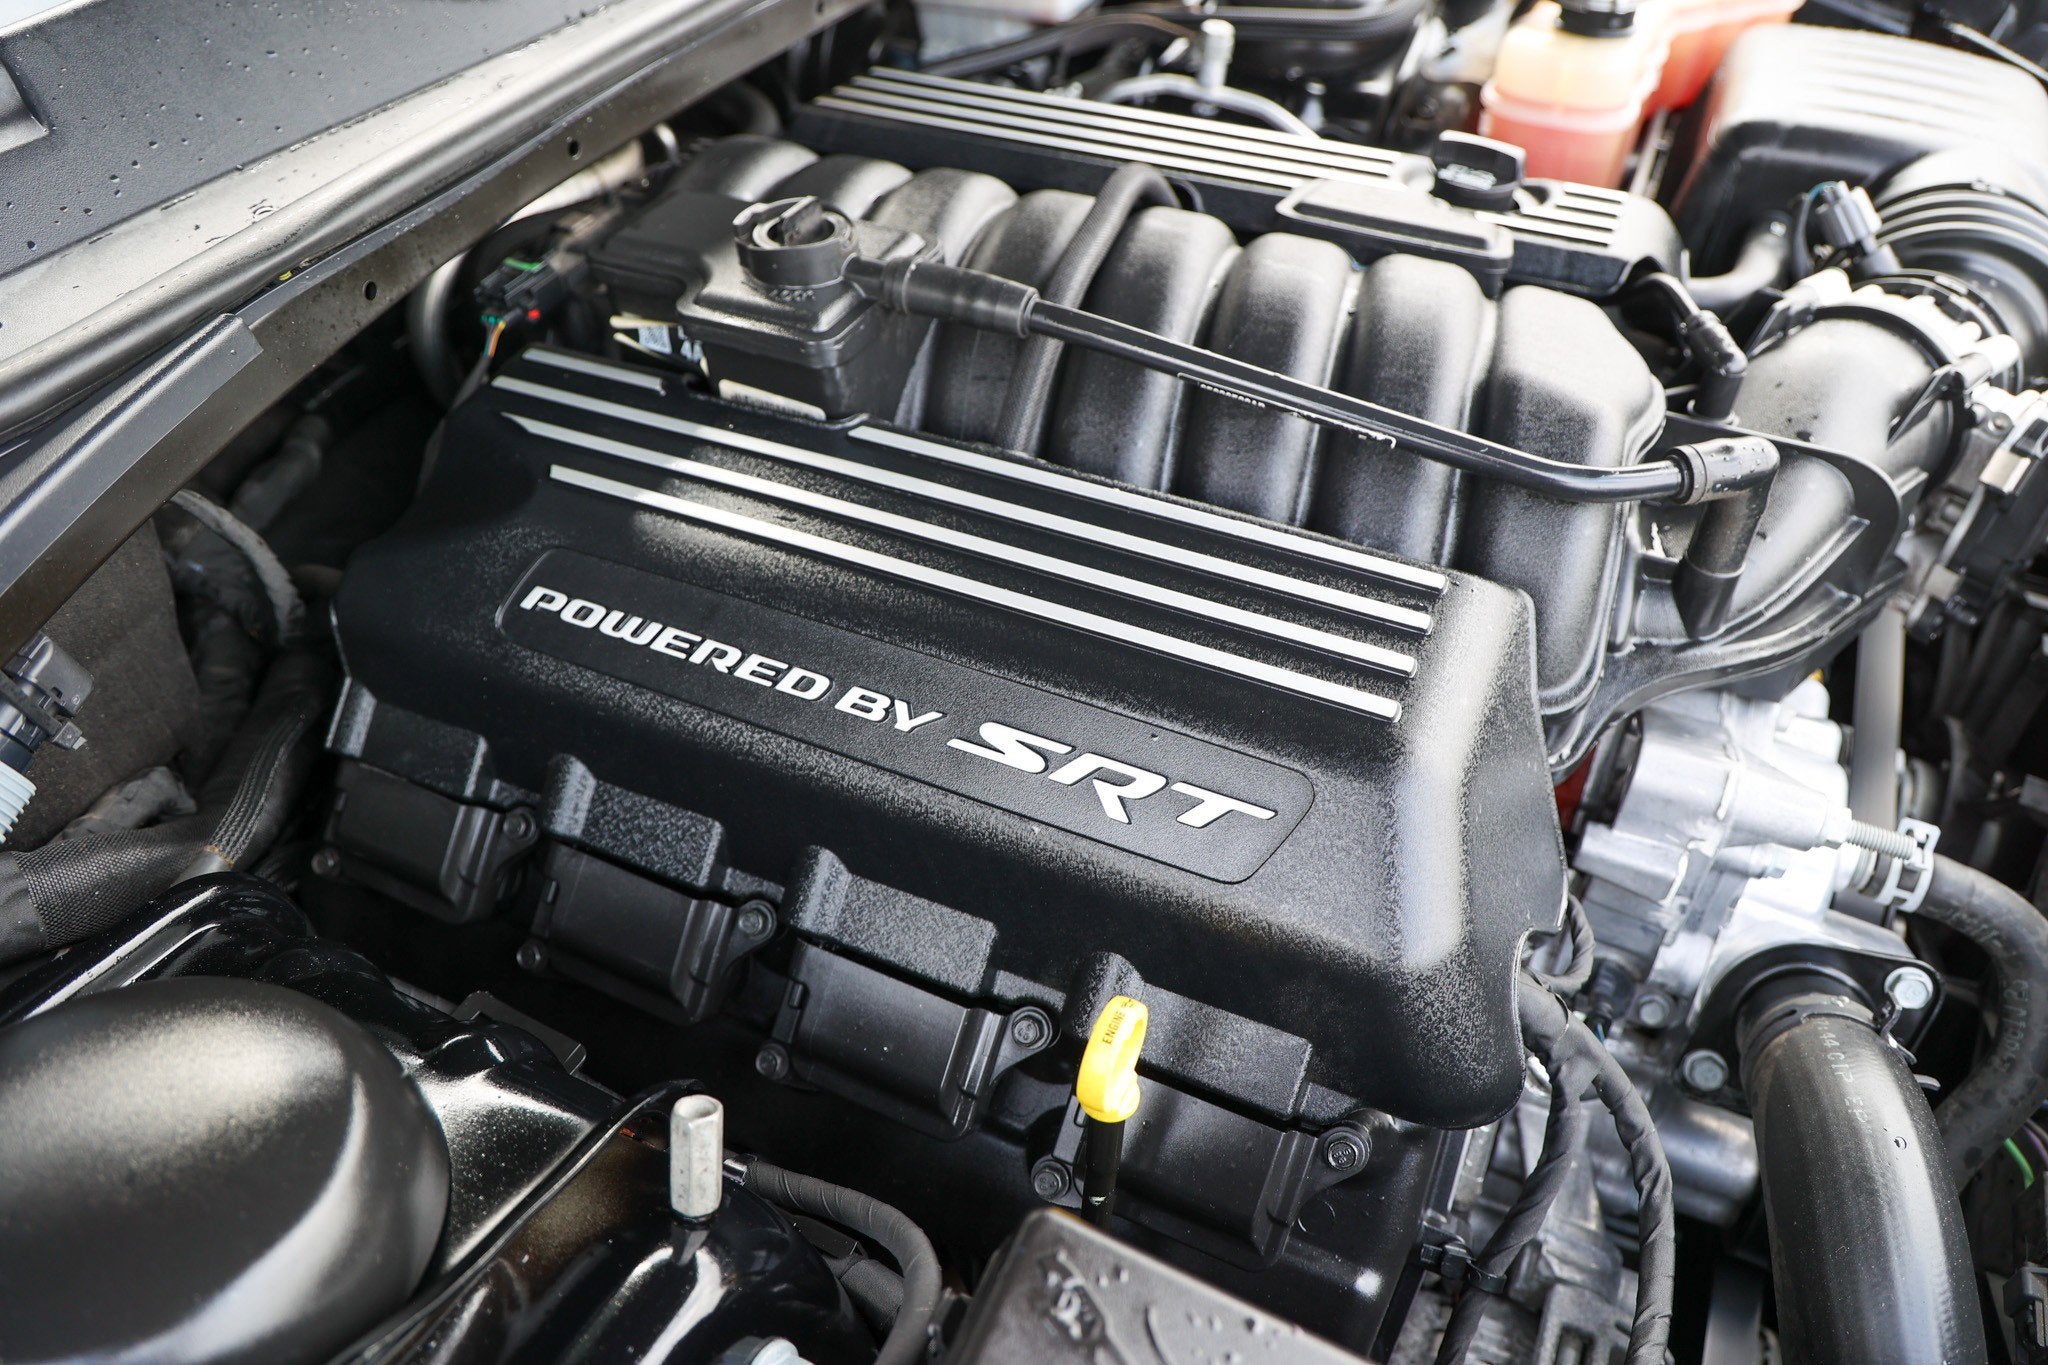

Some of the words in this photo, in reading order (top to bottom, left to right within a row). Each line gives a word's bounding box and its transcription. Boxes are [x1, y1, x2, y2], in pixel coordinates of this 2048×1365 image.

[519, 585, 832, 701] POWERED
[834, 685, 943, 732] BY
[946, 721, 1278, 827] SRT
[1102, 1011, 1126, 1046] ENGINE
